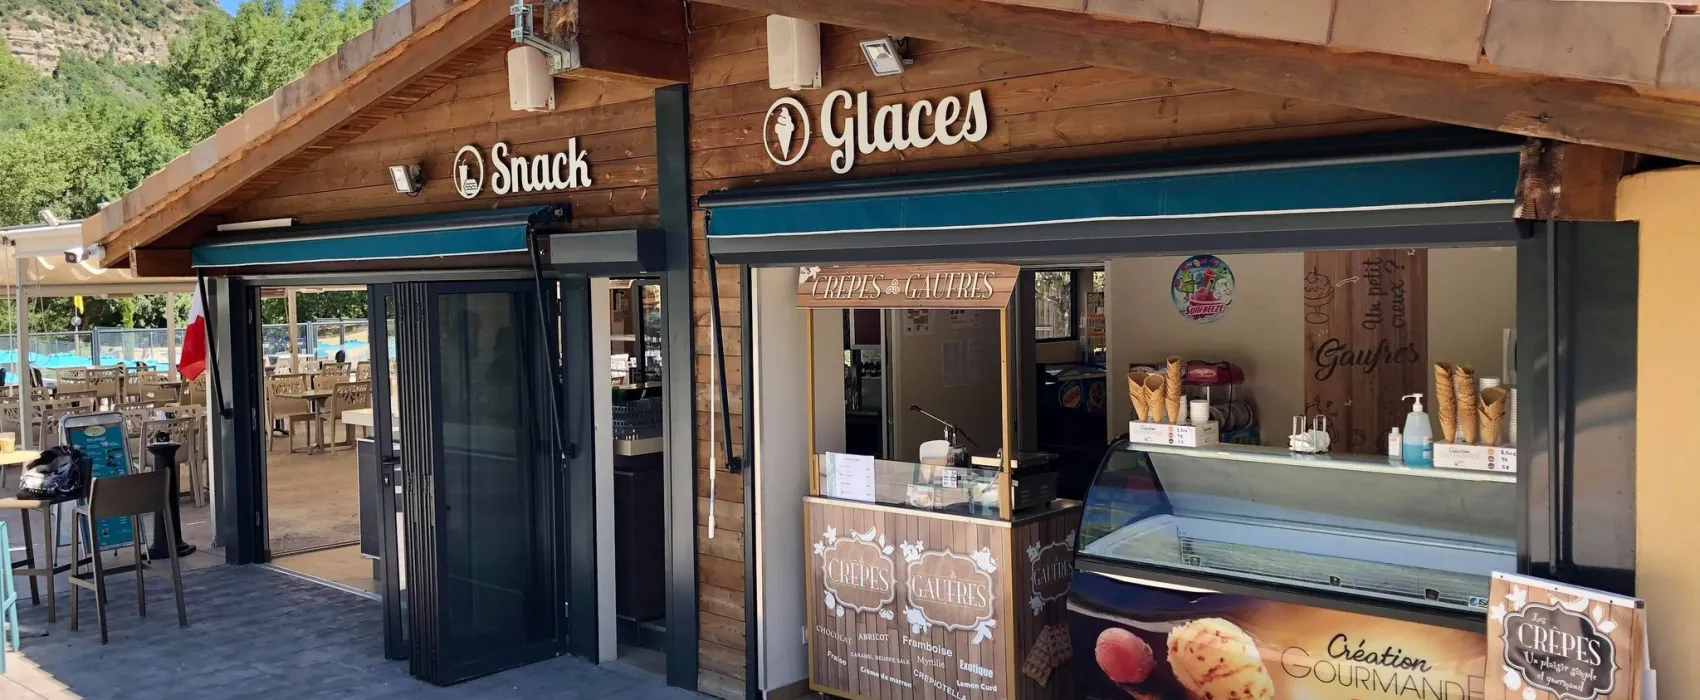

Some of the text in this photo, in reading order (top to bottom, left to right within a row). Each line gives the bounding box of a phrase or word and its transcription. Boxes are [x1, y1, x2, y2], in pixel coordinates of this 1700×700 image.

[819, 89, 988, 175] Glaces
[491, 136, 592, 196] Snack
[811, 270, 996, 300] CRÊPES GAUFRES
[1361, 257, 1388, 331] Un petit
[1390, 278, 1407, 329] creux
[1314, 337, 1420, 381] Gaufres
[828, 557, 889, 592] CRÊPES
[911, 574, 986, 608] GAUFRES
[1531, 612, 1547, 625] Les
[816, 624, 852, 645] CHOCOLAT
[858, 633, 889, 641] ABRICOT
[902, 635, 953, 657] Framboise
[1518, 622, 1602, 667] CRÊPES
[827, 651, 847, 666] Fraise
[850, 652, 874, 660] CARAMEL
[916, 654, 945, 669] Myrtille
[1326, 632, 1432, 673] Création
[959, 659, 993, 679] Exotique
[1523, 650, 1597, 683] Un plaisir simple
[880, 672, 889, 681] de
[889, 676, 912, 688] marron
[956, 680, 998, 692] Lemon Curd
[1546, 675, 1585, 693] gourmand
